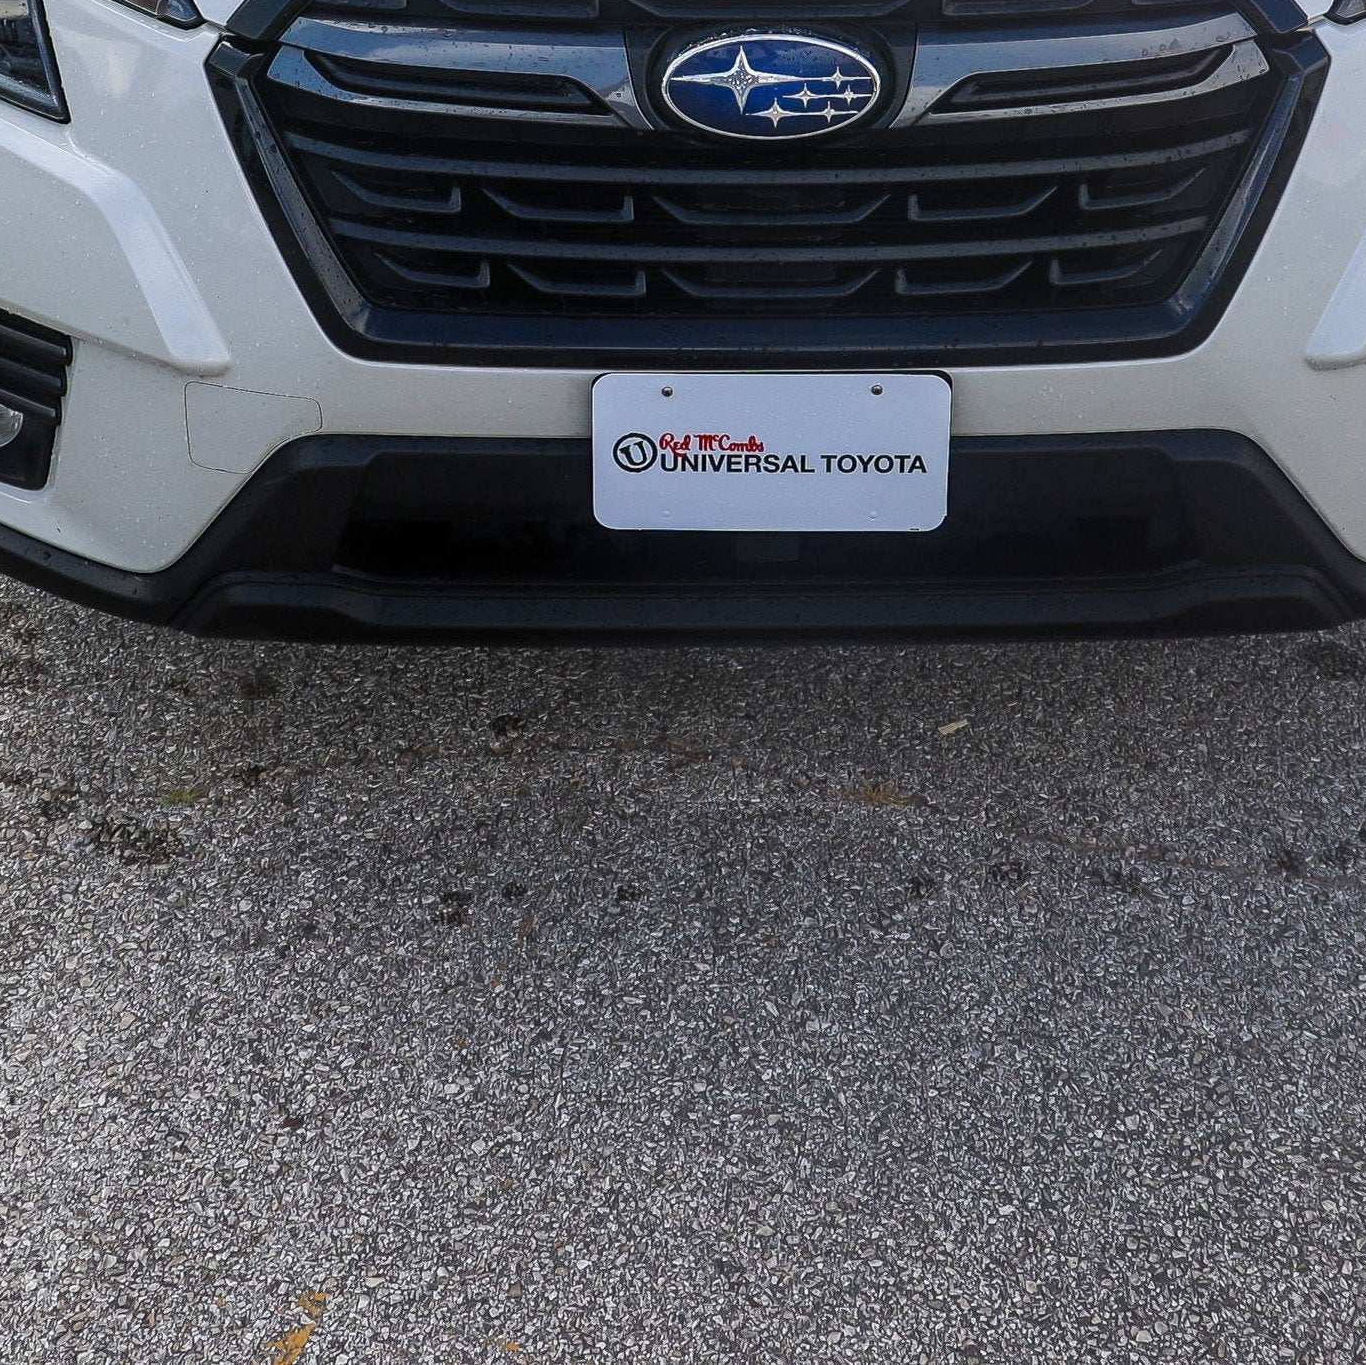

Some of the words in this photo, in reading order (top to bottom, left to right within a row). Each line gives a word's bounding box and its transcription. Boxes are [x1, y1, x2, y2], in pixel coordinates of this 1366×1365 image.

[659, 432, 691, 457] Red
[693, 434, 765, 453] McCombs
[660, 453, 815, 473] UNIVERSAL
[820, 454, 928, 474] TOYOTA
